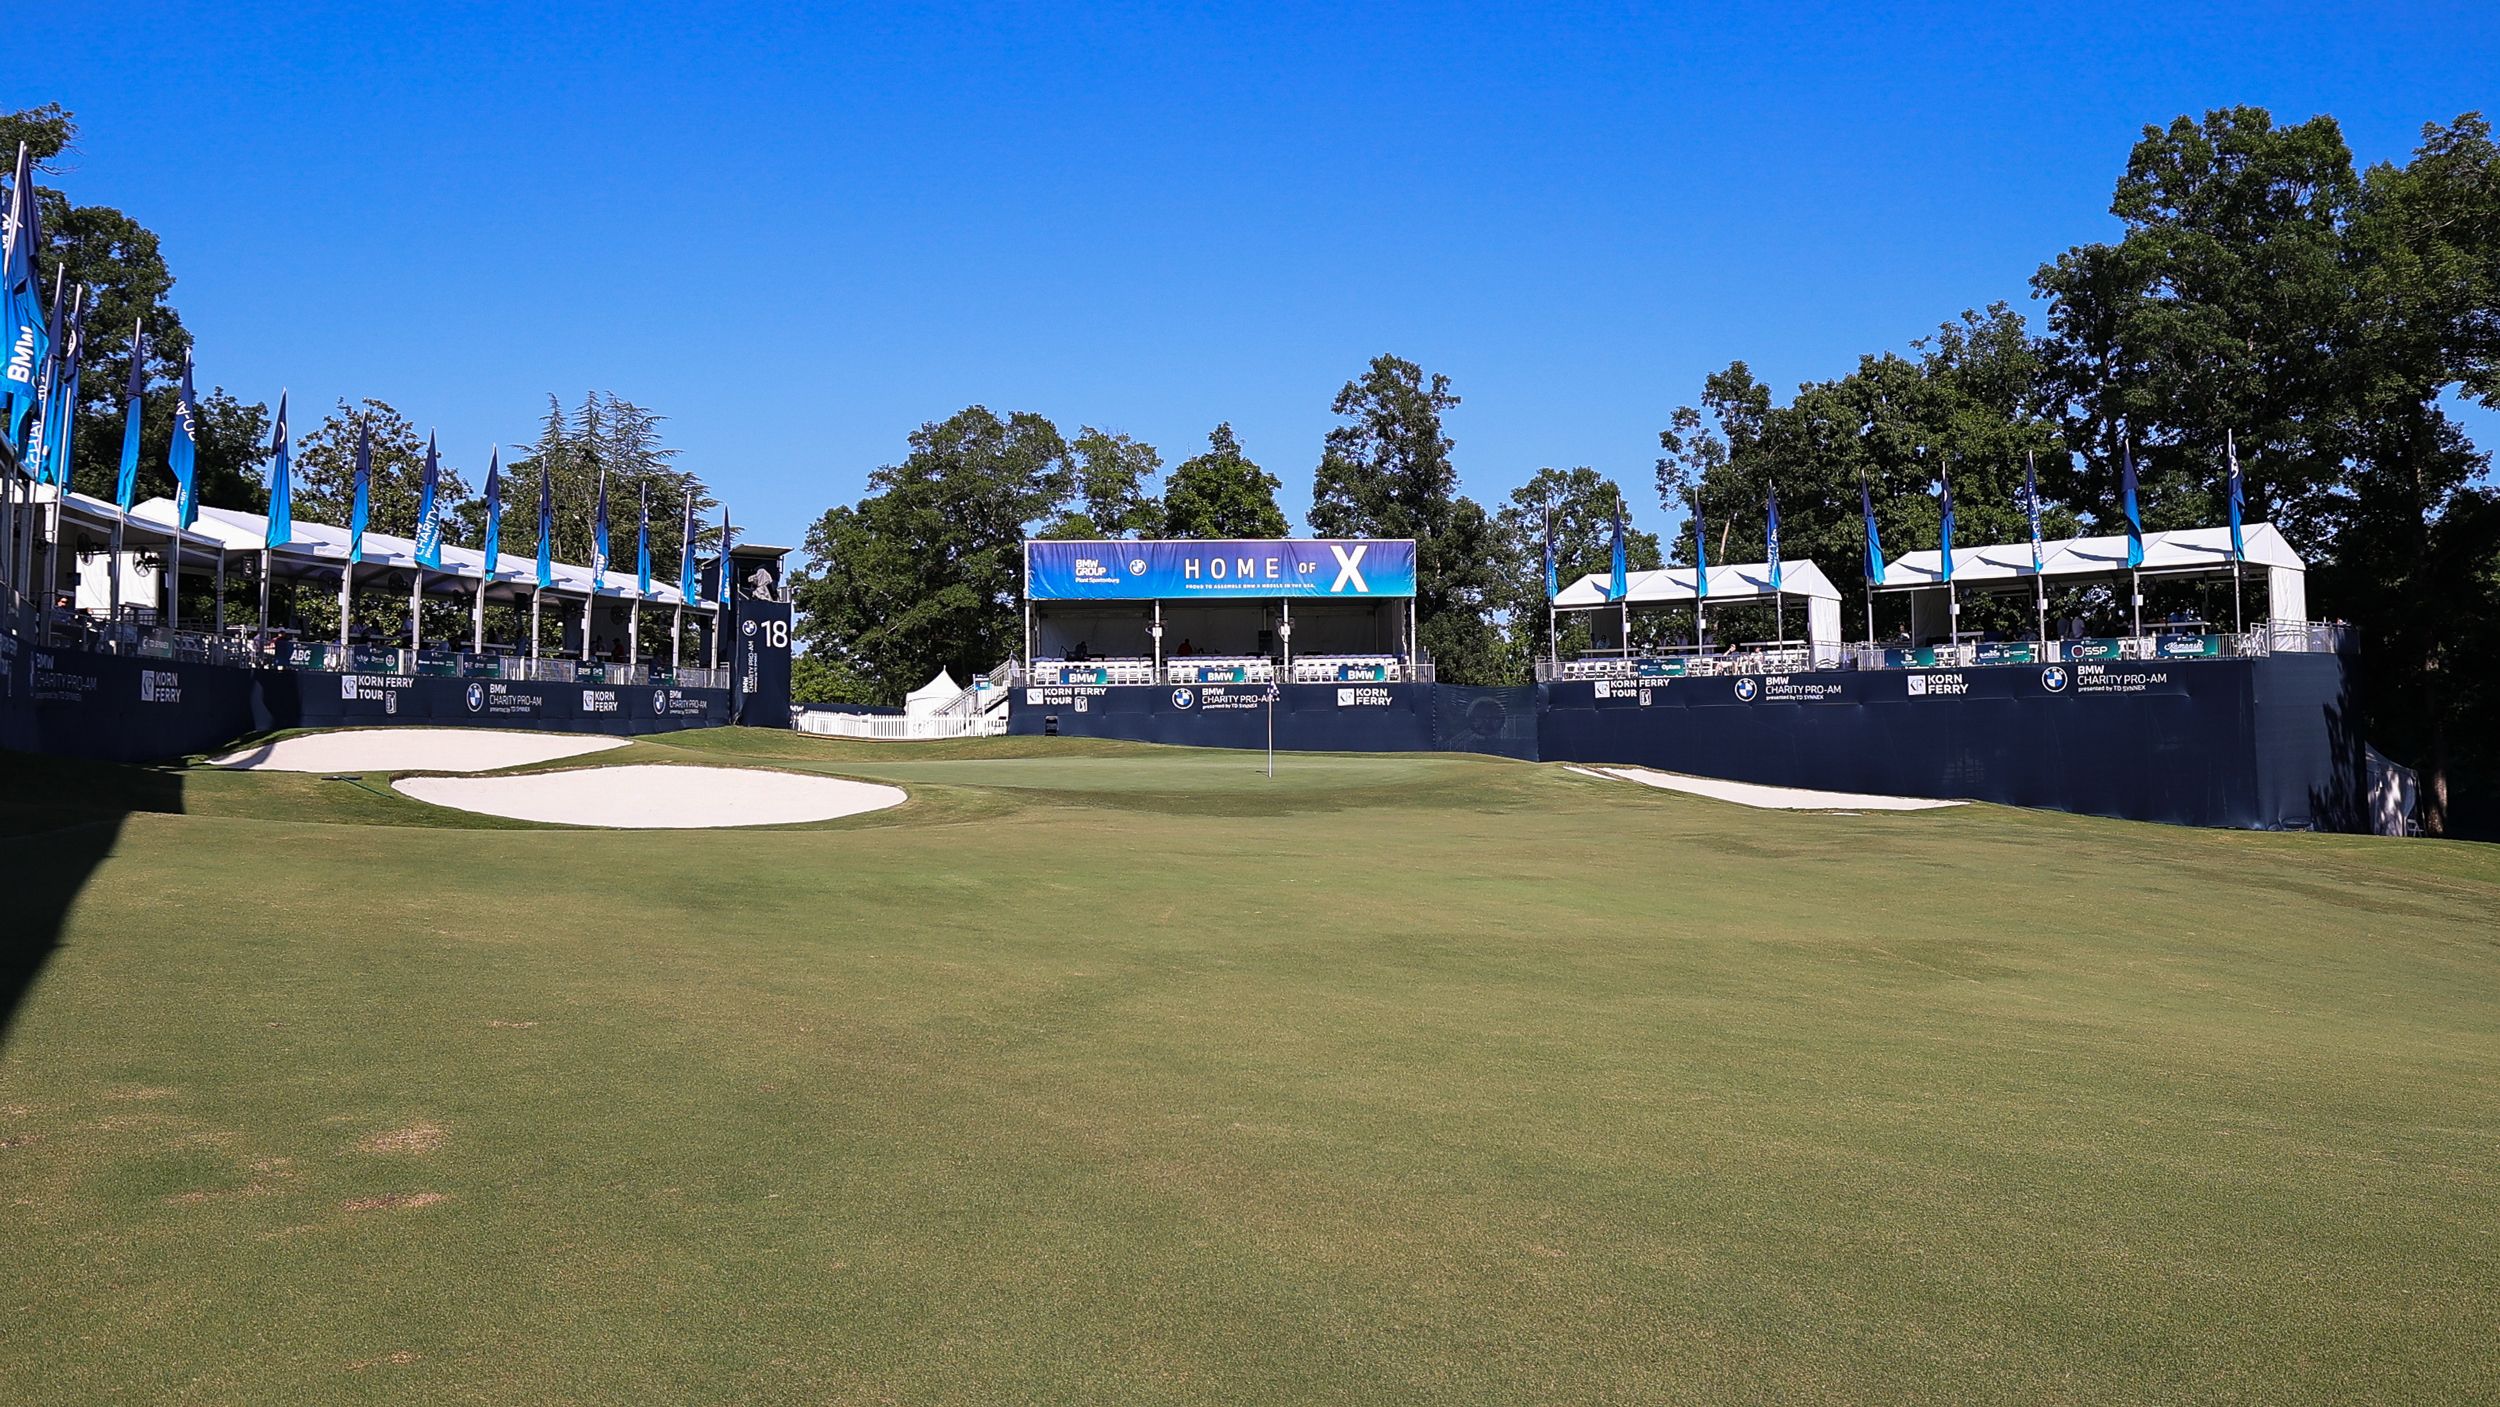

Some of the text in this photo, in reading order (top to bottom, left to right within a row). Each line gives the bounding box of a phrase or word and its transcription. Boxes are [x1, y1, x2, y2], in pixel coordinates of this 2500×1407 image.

[7, 325, 34, 383] BMW
[416, 506, 438, 555] CHARITY
[1075, 559, 1099, 568] BMW
[1075, 567, 1107, 576] GROUP
[1185, 545, 1370, 593] HOME OF X
[760, 620, 788, 648] 18
[289, 650, 311, 661] ABC
[1347, 670, 1375, 680] BMW
[2077, 665, 2105, 675] BMW
[155, 671, 178, 686] KORN
[358, 675, 414, 688] KORN FERRY
[1069, 673, 1097, 683] BMW
[1207, 672, 1234, 681] BMW
[1765, 676, 1789, 685] BMW
[1927, 674, 1963, 684] KORN
[2077, 673, 2167, 685] CHARITY PRO-AM
[489, 683, 507, 694] BMW
[1610, 679, 1670, 688] KORN FERRY
[358, 689, 384, 700] TOUR
[1044, 687, 1107, 696] KORN FERRY
[1202, 687, 1225, 695] BMW
[1356, 688, 1388, 697] KORN
[1611, 689, 1637, 698] TOUR
[1765, 685, 1842, 694] CHARITY PRO-AM
[1927, 684, 1969, 695] FERRY
[155, 687, 182, 703] FERRY
[489, 694, 542, 706] CHARITY PRO-AM
[594, 691, 615, 700] KORN
[1202, 695, 1274, 704] CHARITY PRO-A
[1044, 696, 1072, 705] TOUR
[1356, 697, 1393, 706] FERRY
[594, 701, 618, 712] FERRY
